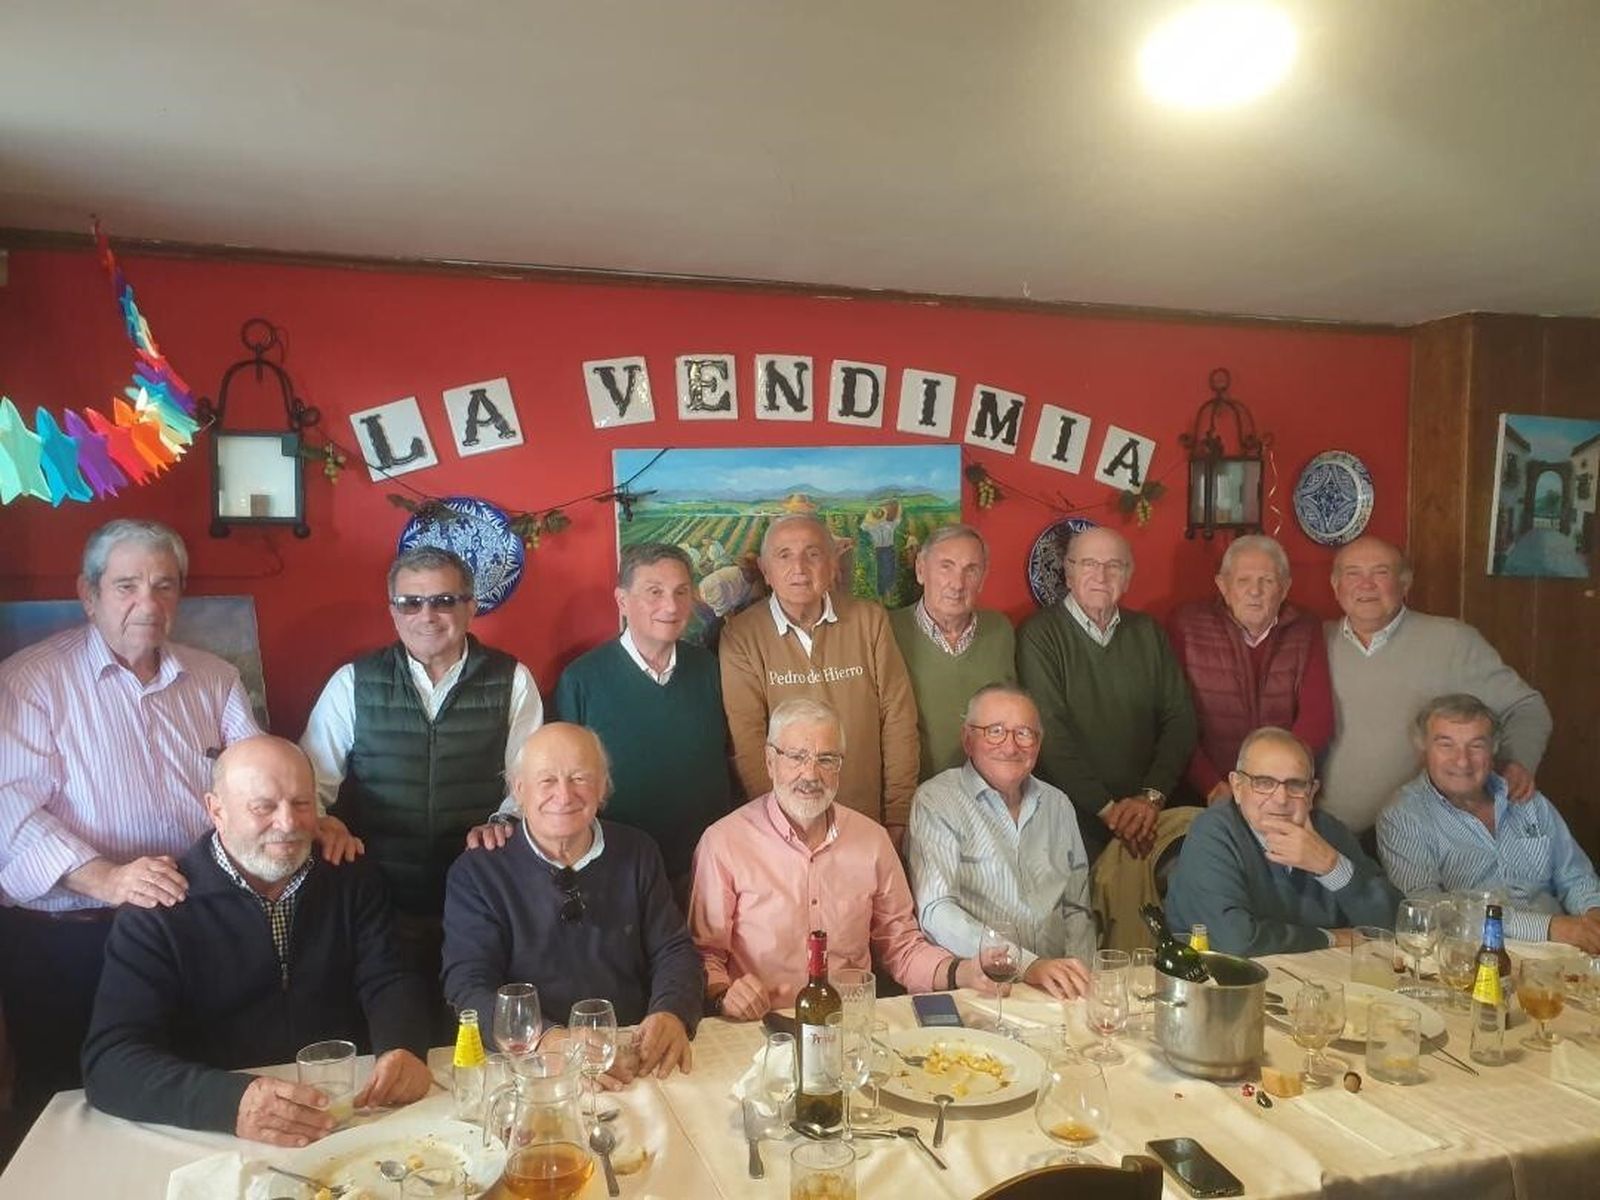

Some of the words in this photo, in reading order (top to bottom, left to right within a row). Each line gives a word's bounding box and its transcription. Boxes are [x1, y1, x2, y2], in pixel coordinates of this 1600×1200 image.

[360, 388, 516, 470] LA
[592, 359, 1142, 486] VENDIMIA
[769, 669, 806, 685] Pedro
[807, 669, 821, 684] de
[823, 665, 864, 682] Hierro
